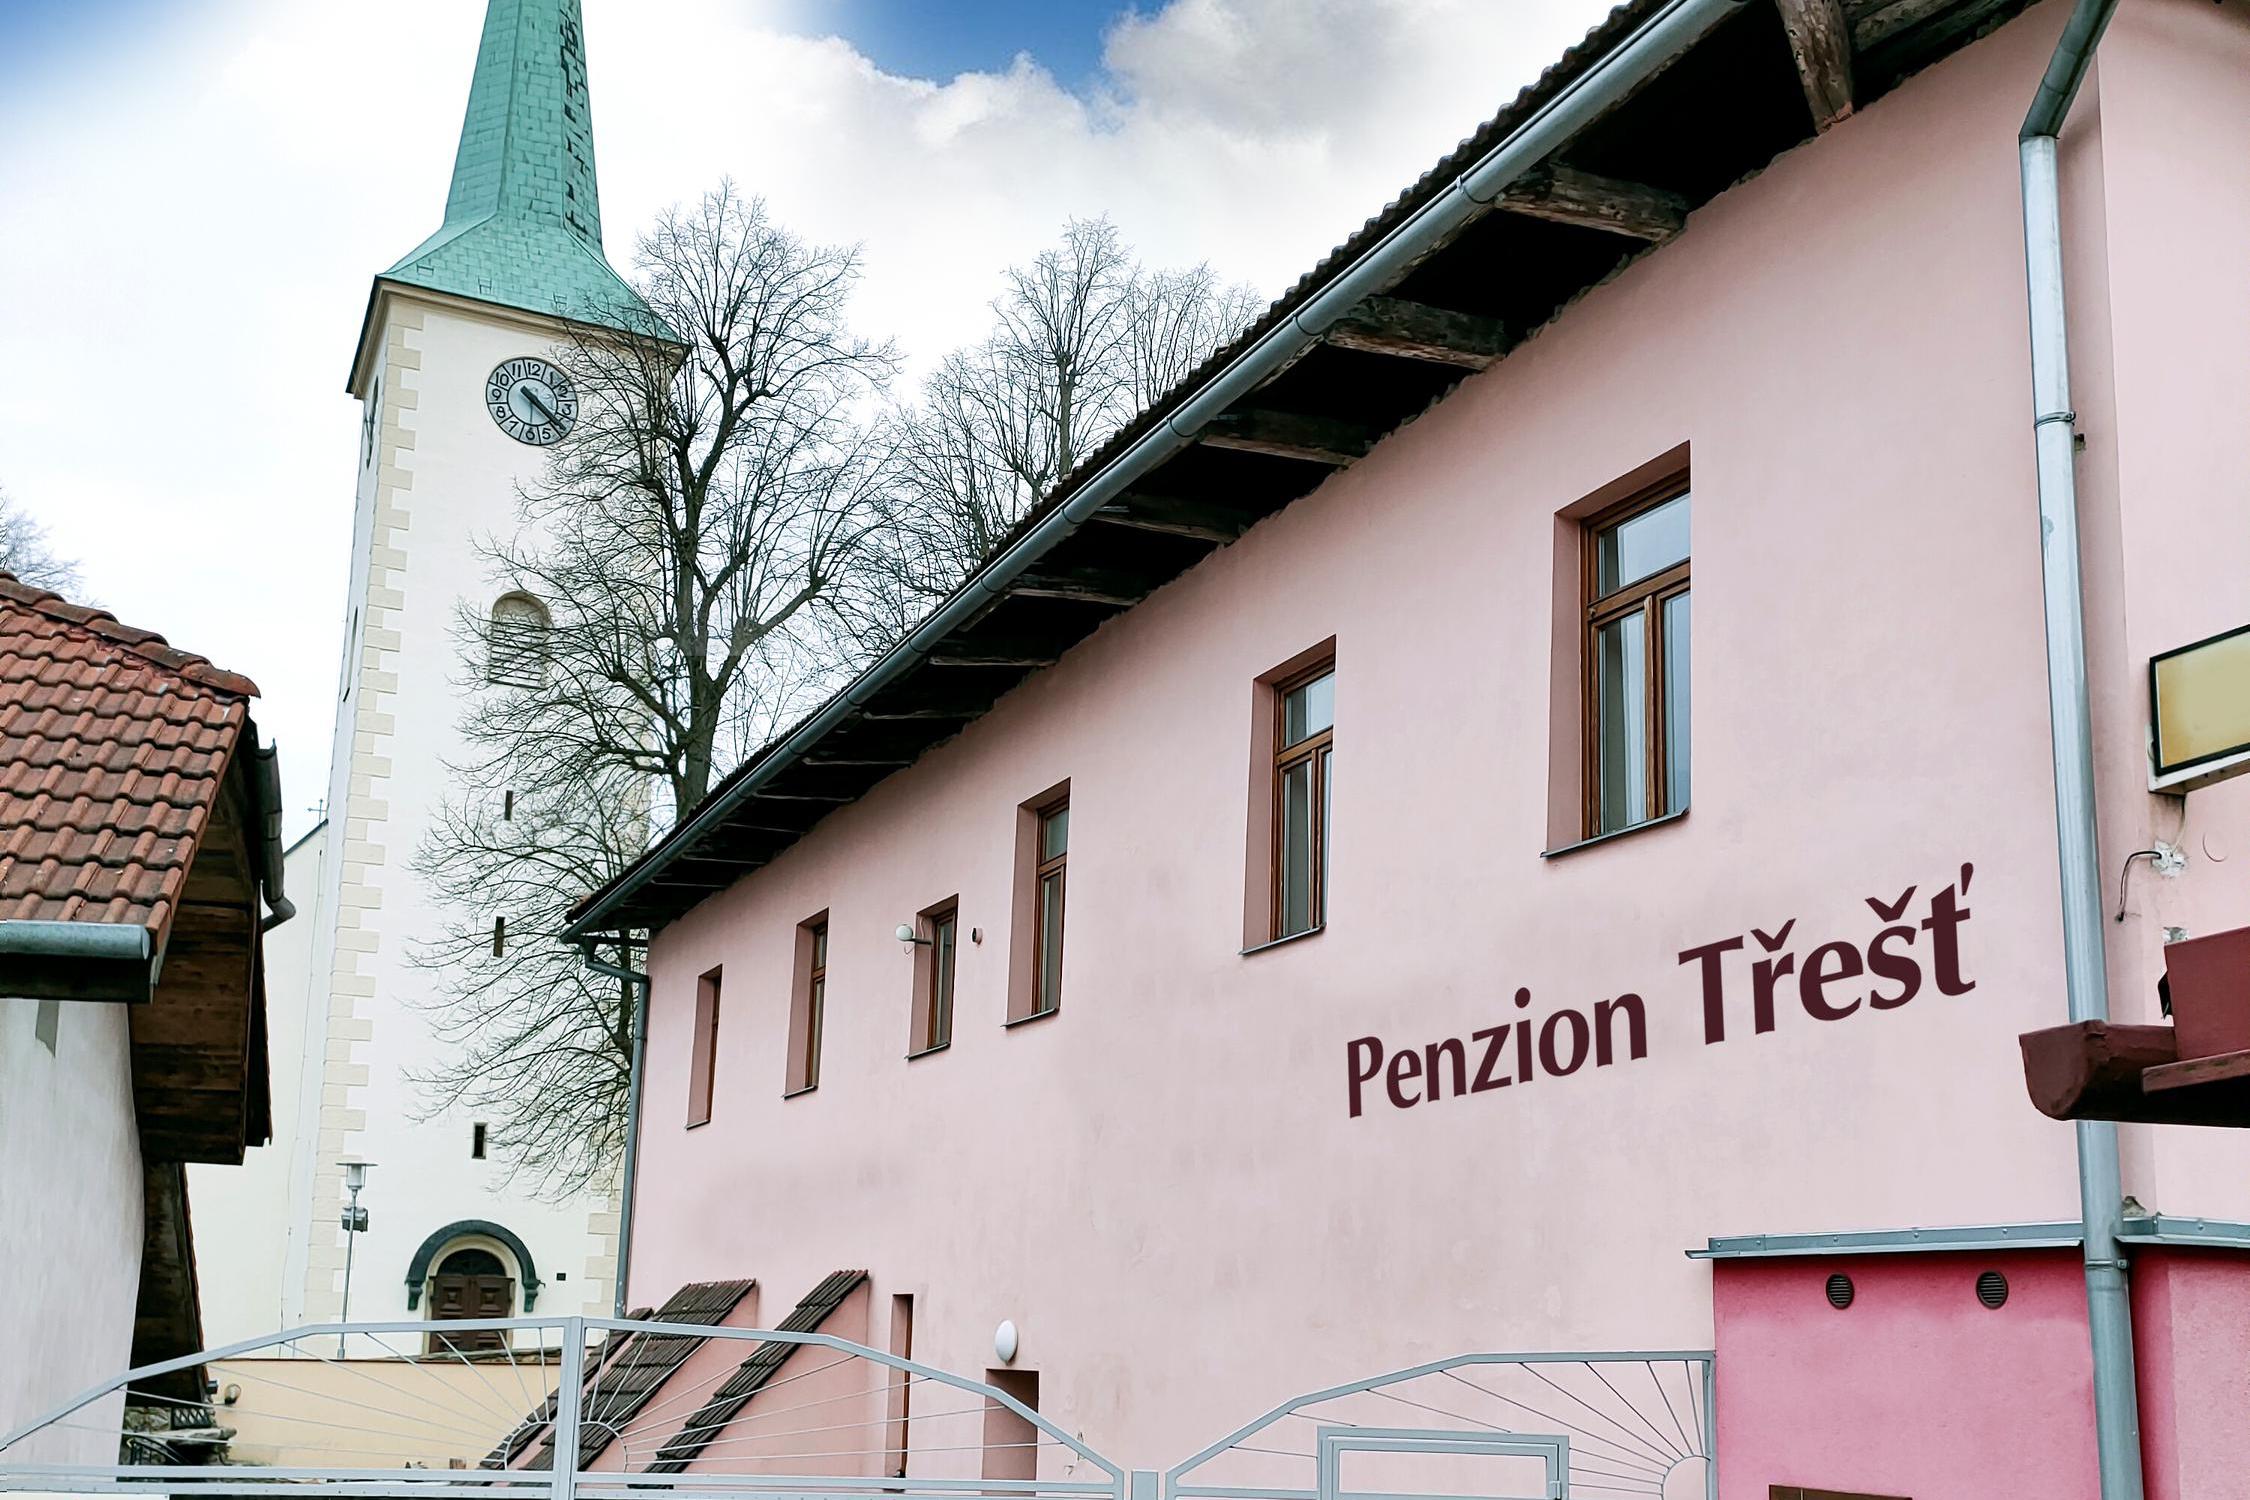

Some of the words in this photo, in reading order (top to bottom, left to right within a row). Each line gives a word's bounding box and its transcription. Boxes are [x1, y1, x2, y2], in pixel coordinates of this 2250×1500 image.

[512, 363, 521, 378] 11
[527, 362, 541, 377] 12
[495, 371, 510, 386] 10
[491, 388, 502, 401] 9
[557, 384, 568, 398] 2
[495, 406, 506, 419] 8
[561, 403, 572, 416] 3
[509, 420, 518, 432] 7
[525, 427, 535, 441] 6
[542, 428, 551, 440] 5
[1347, 986, 1648, 1119] Penzion
[1677, 862, 1976, 1046] Třešť
